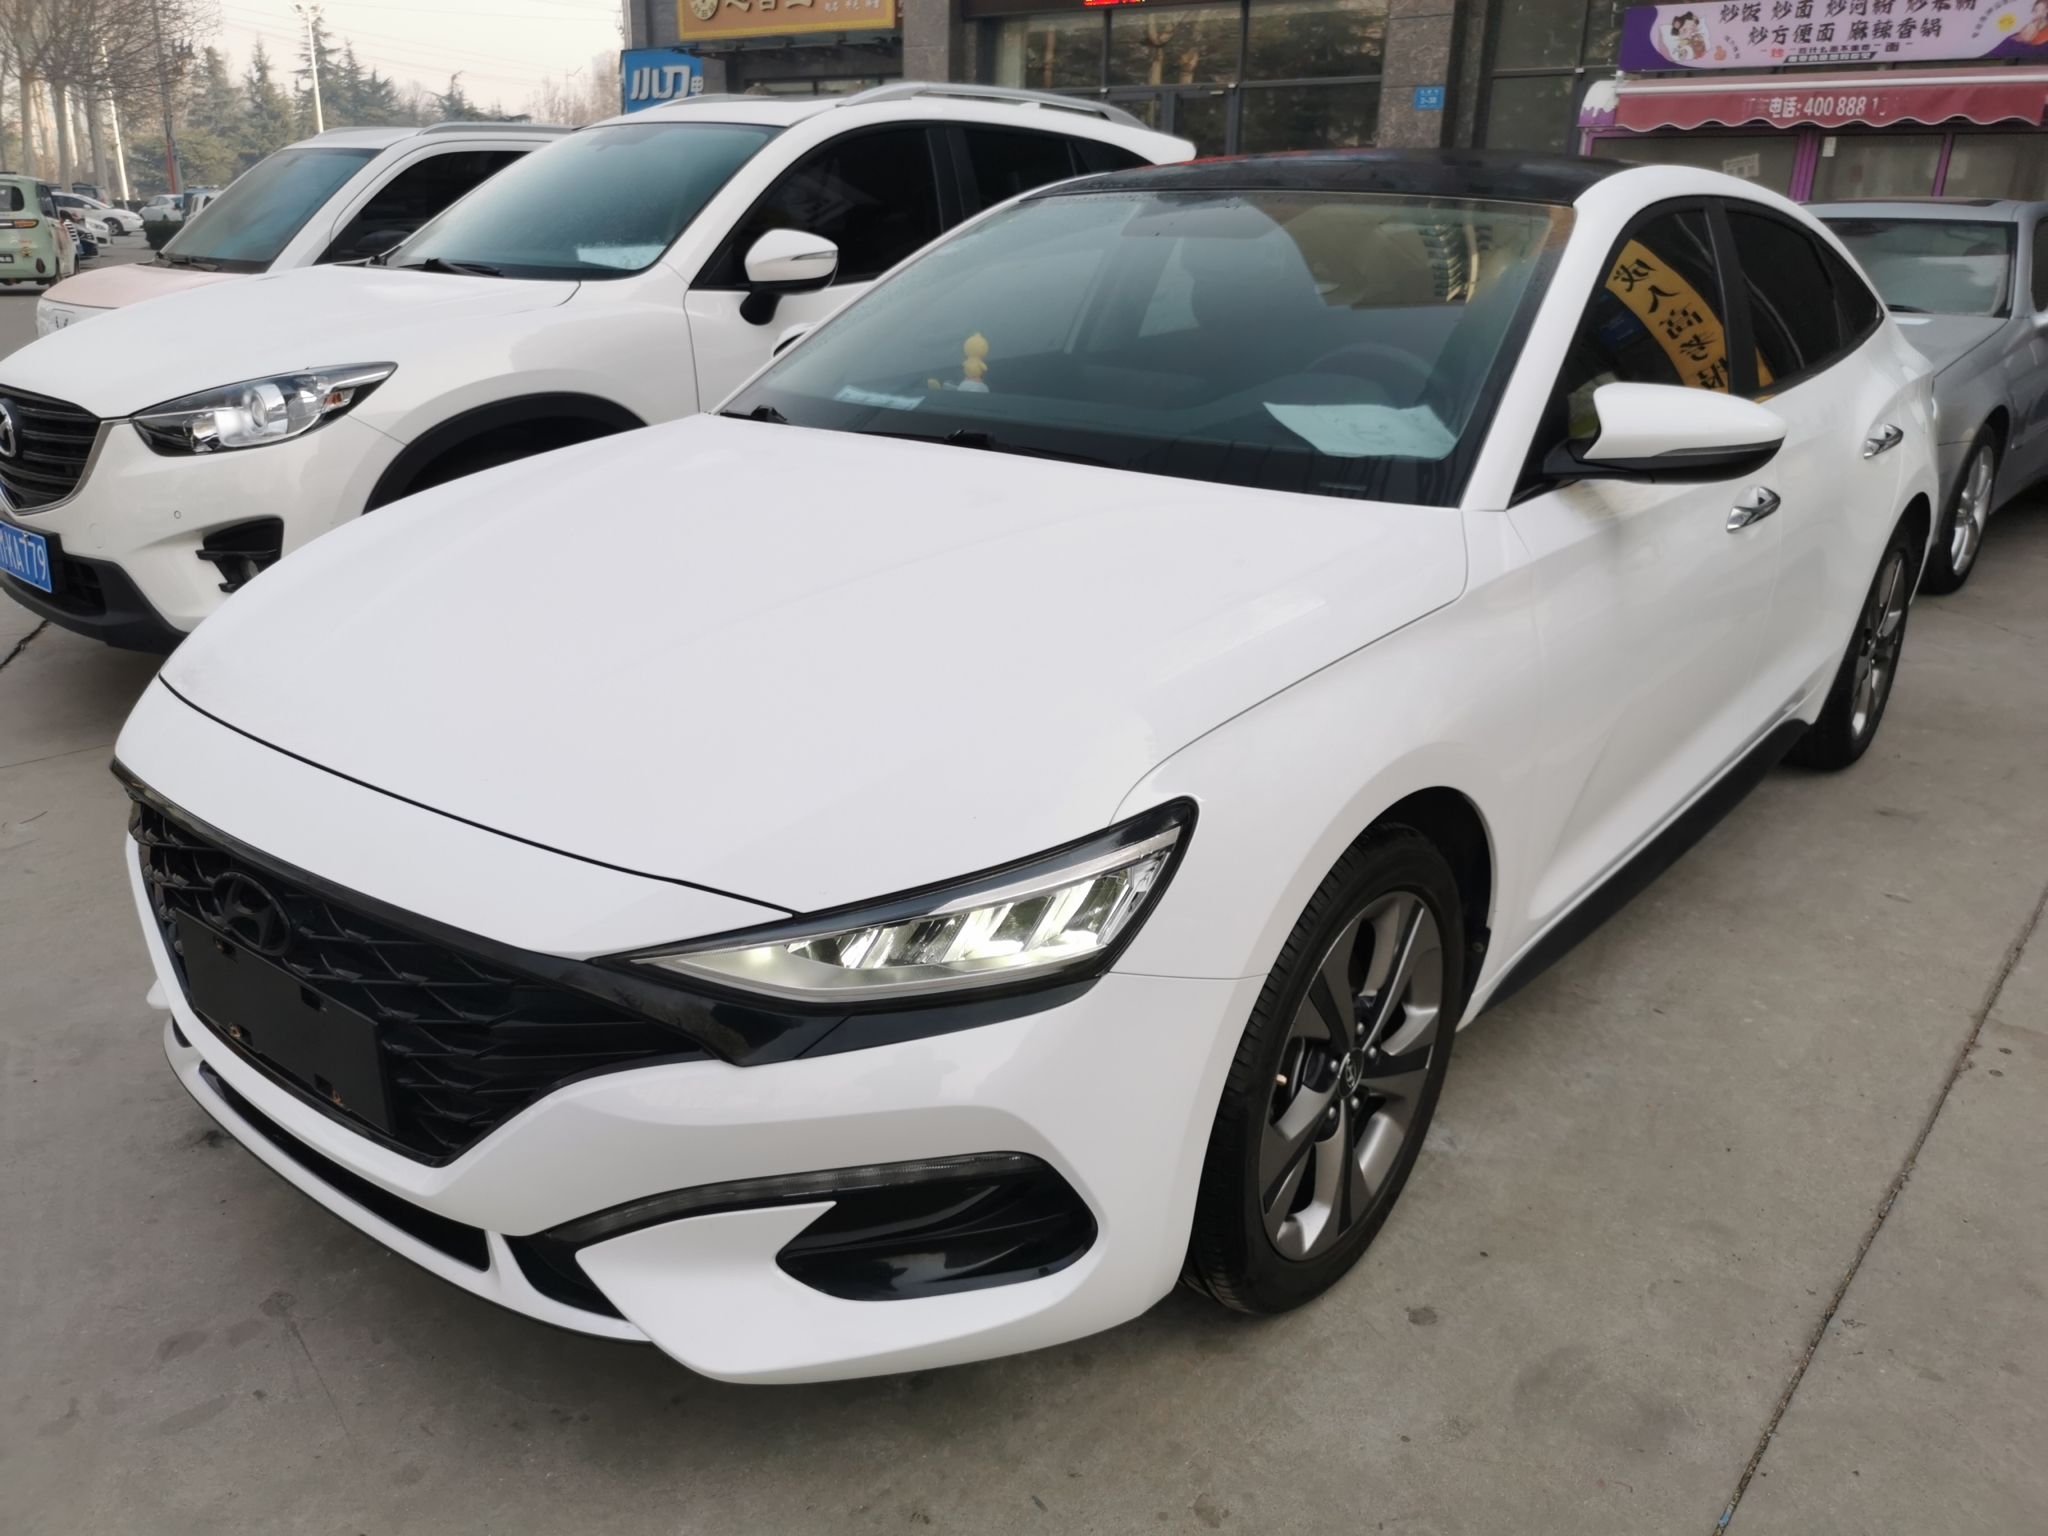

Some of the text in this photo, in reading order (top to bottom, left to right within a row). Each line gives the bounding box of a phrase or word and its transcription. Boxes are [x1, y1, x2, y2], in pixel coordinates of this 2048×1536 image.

[1719, 2, 1763, 24] 炒饭
[1771, 0, 1815, 20] 炒面
[1747, 22, 1836, 47] 炒方便面
[1847, 17, 1942, 41] 麻辣香锅
[1836, 96, 1867, 116] 888
